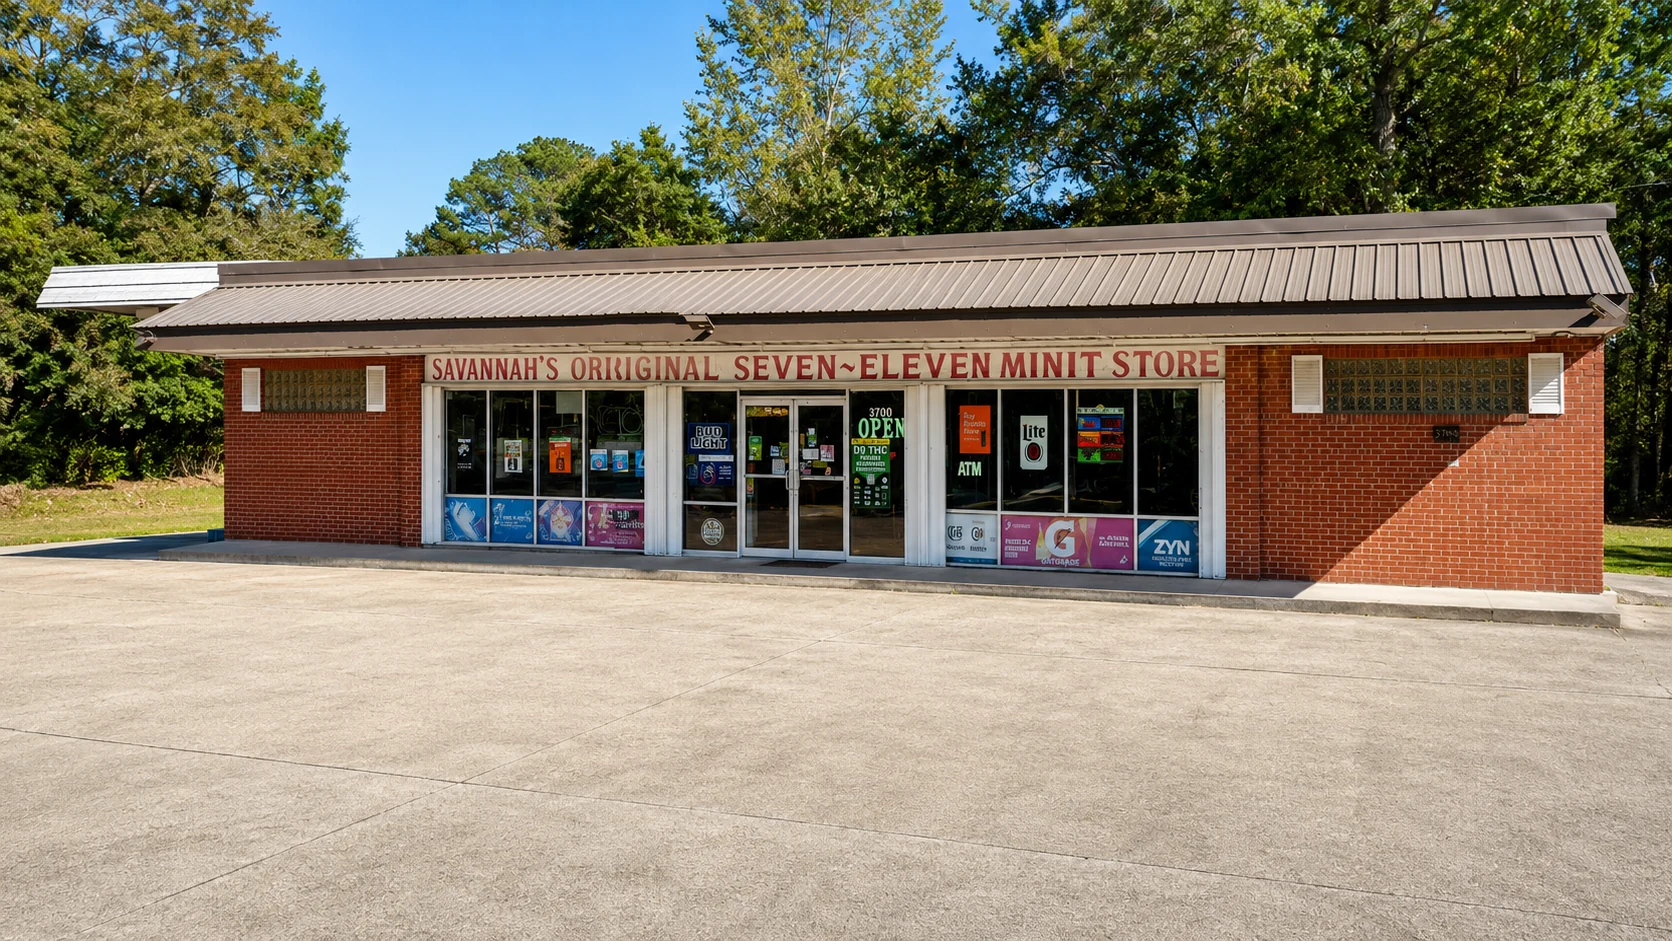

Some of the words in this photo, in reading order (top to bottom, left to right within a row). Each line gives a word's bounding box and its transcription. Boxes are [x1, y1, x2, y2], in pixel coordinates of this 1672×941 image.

[432, 355, 559, 381] SAVANNAH'S
[1000, 350, 1102, 379] MINIT
[1112, 349, 1220, 378] STORE
[869, 407, 893, 418] 3700
[695, 425, 723, 438] BUD
[858, 417, 904, 439] OPEN
[1022, 424, 1046, 442] Lite
[690, 437, 728, 450] LIGHT
[867, 445, 888, 455] THC
[957, 461, 982, 477] ATM
[1153, 539, 1190, 556] ZYN
